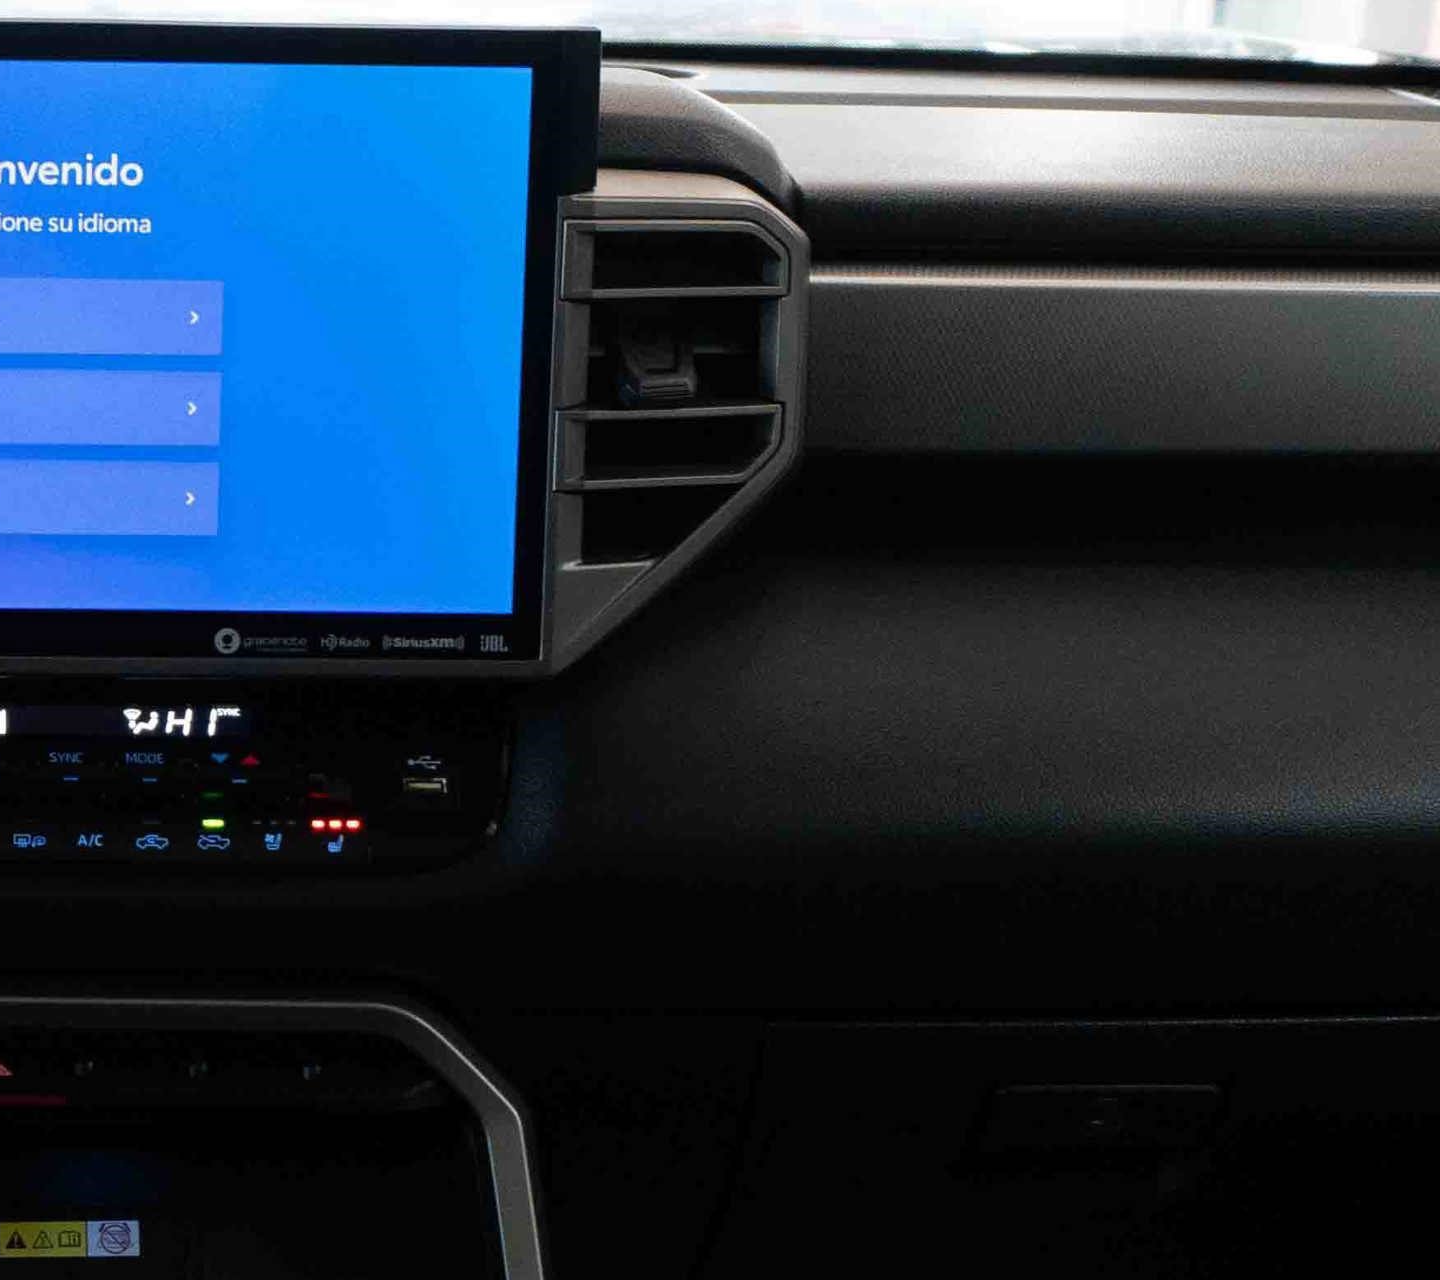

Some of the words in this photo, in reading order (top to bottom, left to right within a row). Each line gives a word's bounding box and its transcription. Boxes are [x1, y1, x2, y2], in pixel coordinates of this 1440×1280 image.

[47, 216, 74, 233] su
[77, 213, 153, 234] idioma
[339, 637, 369, 648] Radio
[480, 634, 509, 653] JBL
[48, 751, 84, 764] SYNC
[125, 752, 165, 765] MODE
[76, 832, 105, 848] A/C
